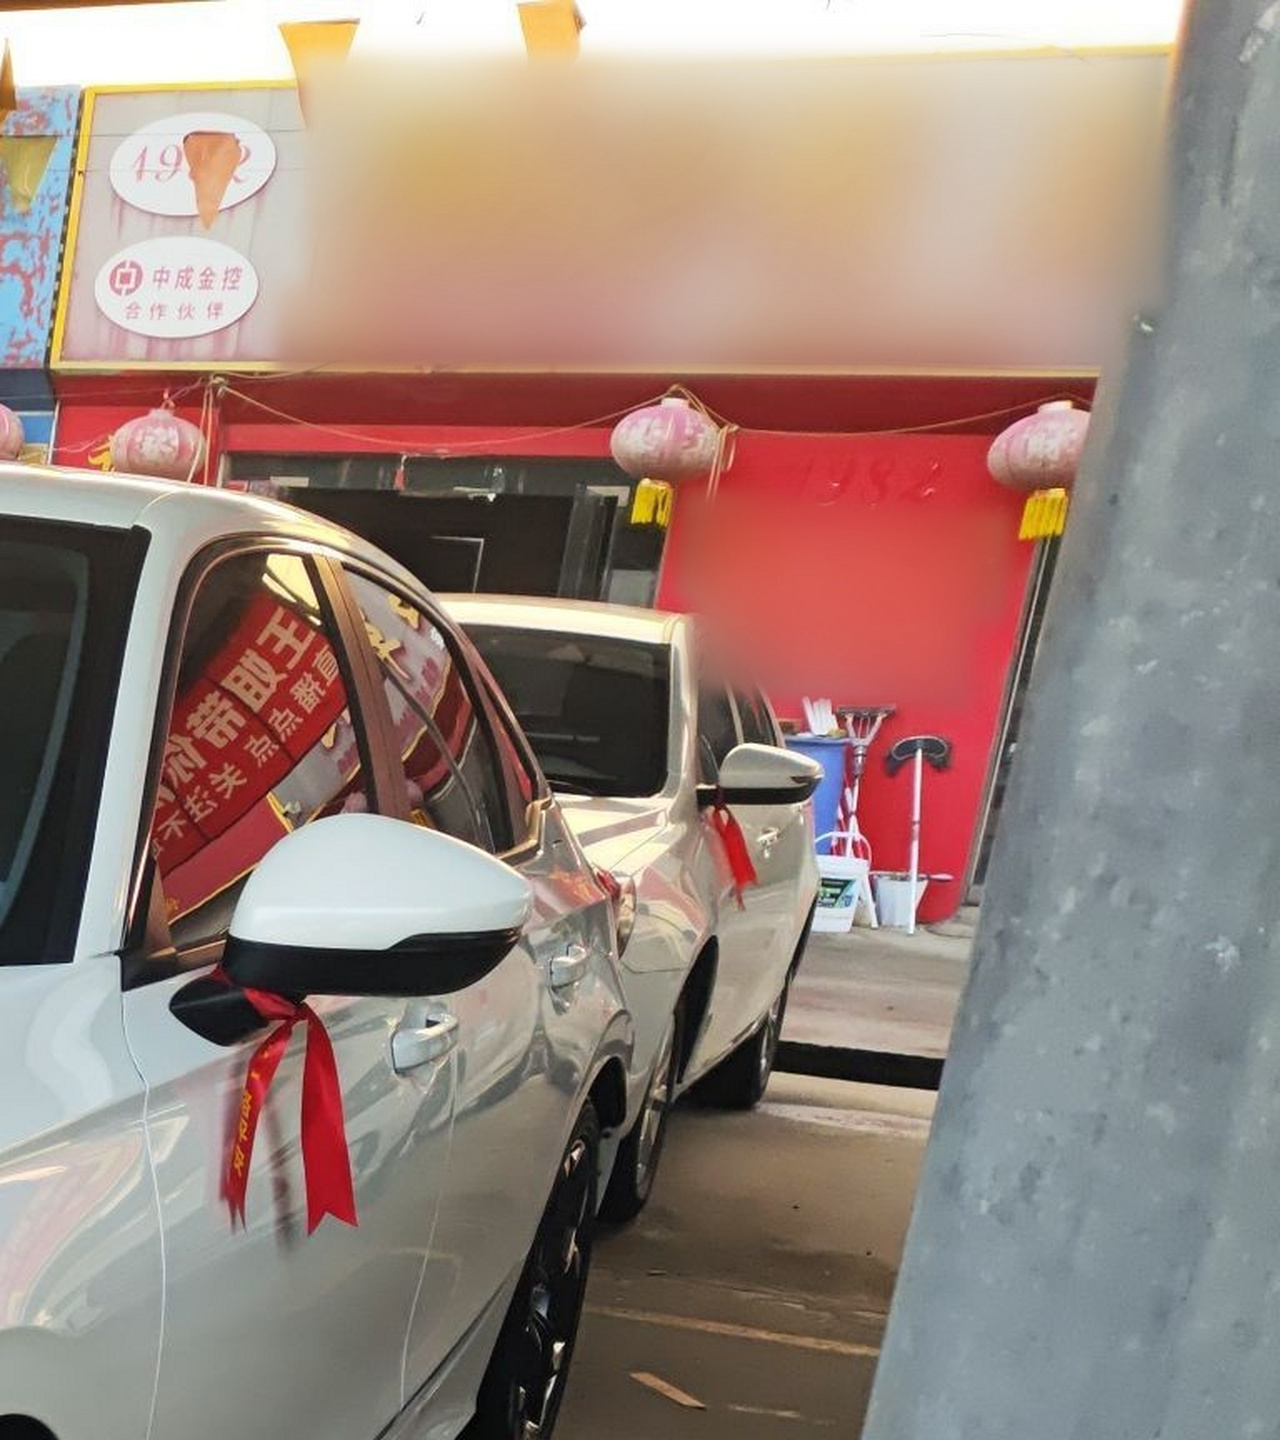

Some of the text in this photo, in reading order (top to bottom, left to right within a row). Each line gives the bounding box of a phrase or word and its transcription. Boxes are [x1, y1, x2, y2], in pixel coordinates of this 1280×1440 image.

[132, 144, 252, 184] 192
[152, 266, 243, 291] 中成金控
[125, 301, 224, 320] 合作伙伴
